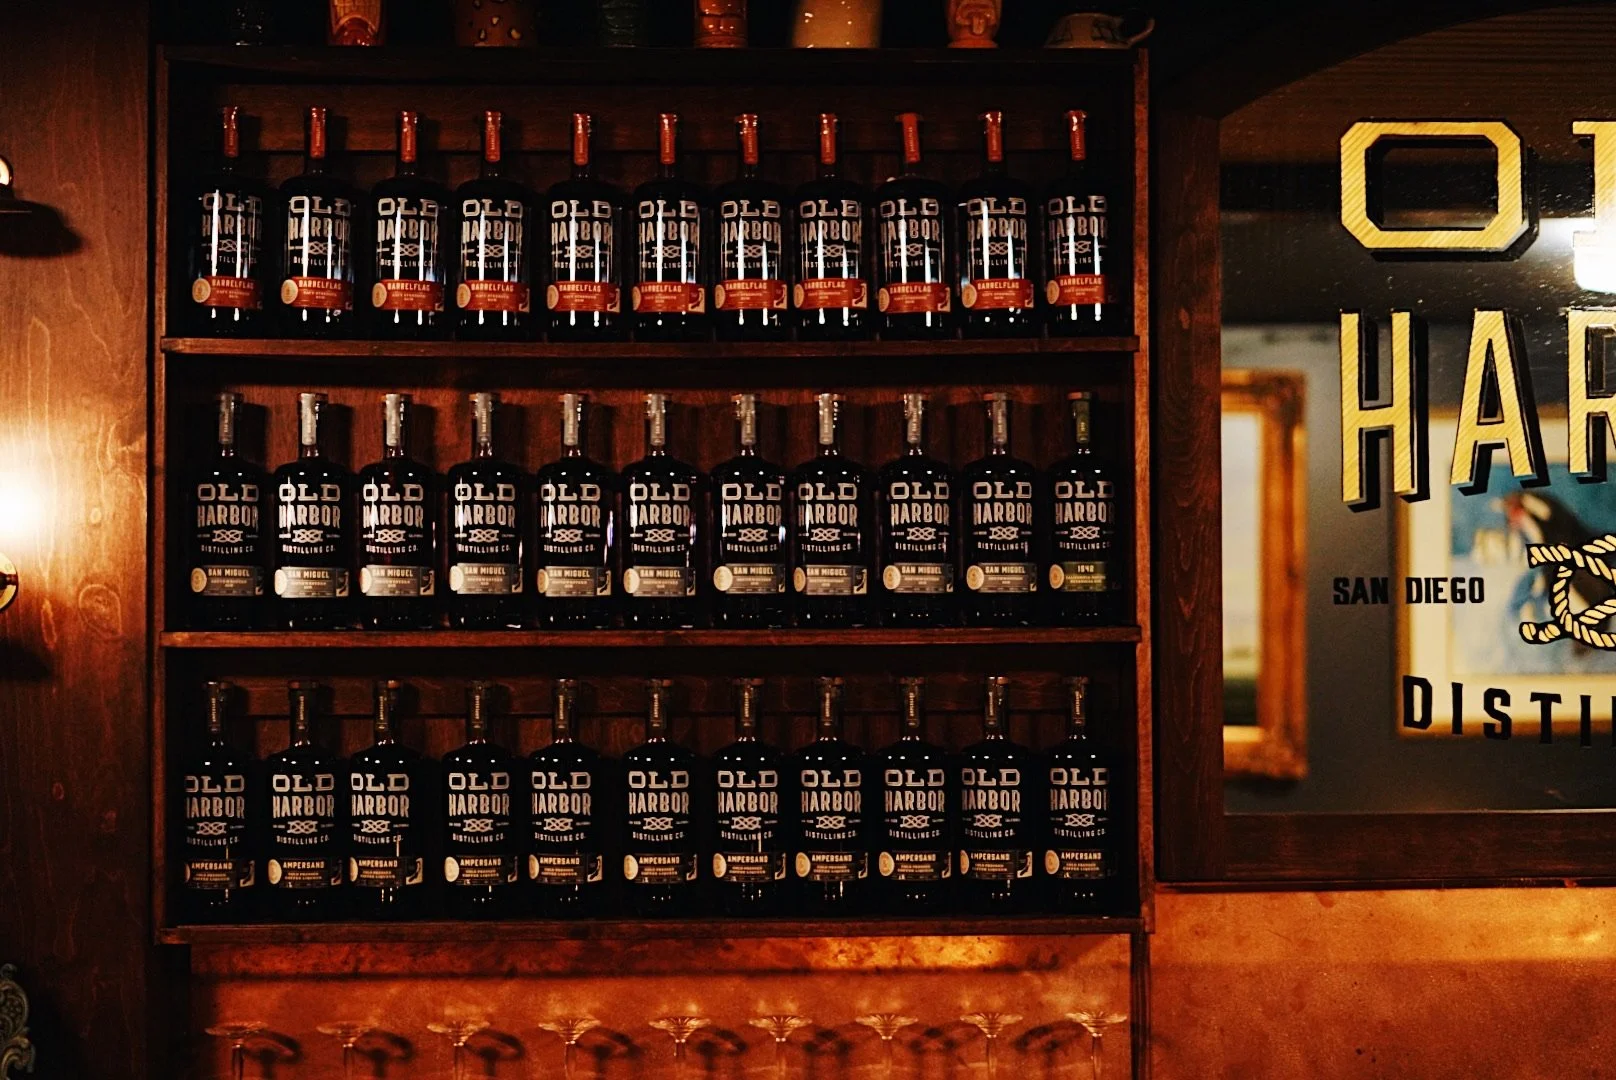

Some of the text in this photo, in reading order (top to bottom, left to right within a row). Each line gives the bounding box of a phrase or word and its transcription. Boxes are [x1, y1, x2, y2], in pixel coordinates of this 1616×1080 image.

[198, 484, 259, 501] OLD
[279, 484, 340, 501] OLD
[363, 483, 423, 501] OLD
[455, 483, 515, 501] OLD
[541, 484, 600, 501] OLD
[630, 483, 690, 501] OLD
[722, 483, 781, 500] OLD
[799, 483, 857, 500] OLD
[891, 482, 949, 499] OLD
[973, 482, 1032, 499] OLD
[1056, 481, 1114, 498] OLD
[197, 505, 258, 528] HARBOR
[279, 504, 340, 528] HARBOR
[363, 504, 423, 528] HARBOR
[455, 504, 515, 528] HARBOR
[891, 503, 949, 526] HARBOR
[973, 502, 1032, 525] HARBOR
[1333, 576, 1485, 604] SAN DIEGO
[1402, 675, 1616, 749] DISTI
[273, 774, 334, 792] OLD
[351, 773, 409, 791] OLD
[449, 773, 509, 790] OLD
[532, 772, 591, 789] OLD
[629, 771, 689, 788] OLD
[718, 770, 778, 788] OLD
[801, 770, 861, 787] OLD
[885, 769, 945, 786] OLD
[962, 768, 1020, 786] OLD
[273, 795, 334, 818] HARBOR
[352, 795, 409, 818] HARBOR
[449, 794, 510, 816] HARBOR
[532, 793, 591, 816] HARBOR
[629, 792, 689, 815] HARBOR
[718, 792, 778, 814] HARBOR
[801, 791, 861, 813] HARBOR
[885, 790, 945, 812] HARBOR
[962, 790, 1020, 812] HARBOR
[460, 858, 501, 866] AMPERSAND
[728, 855, 768, 863] AMPERSAND
[896, 854, 936, 862] AMPERSAND
